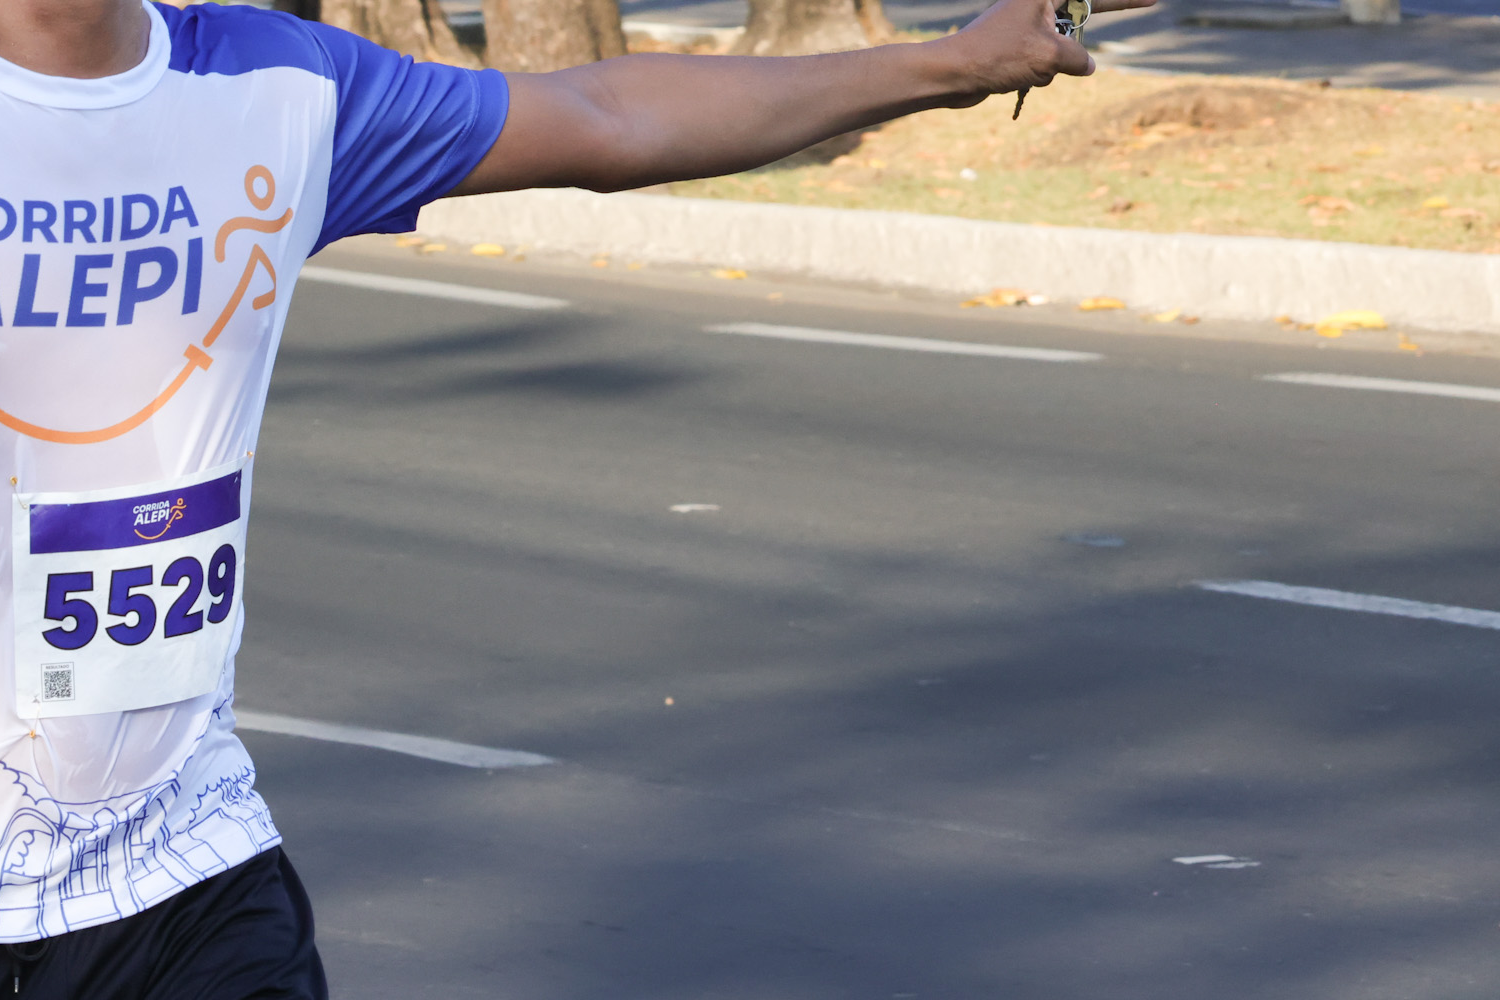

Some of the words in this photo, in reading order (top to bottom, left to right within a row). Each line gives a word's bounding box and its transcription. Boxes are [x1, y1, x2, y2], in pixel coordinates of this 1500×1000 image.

[132, 500, 170, 515] CORRIDA
[133, 508, 170, 526] ALEPI
[41, 543, 237, 651] 5529
